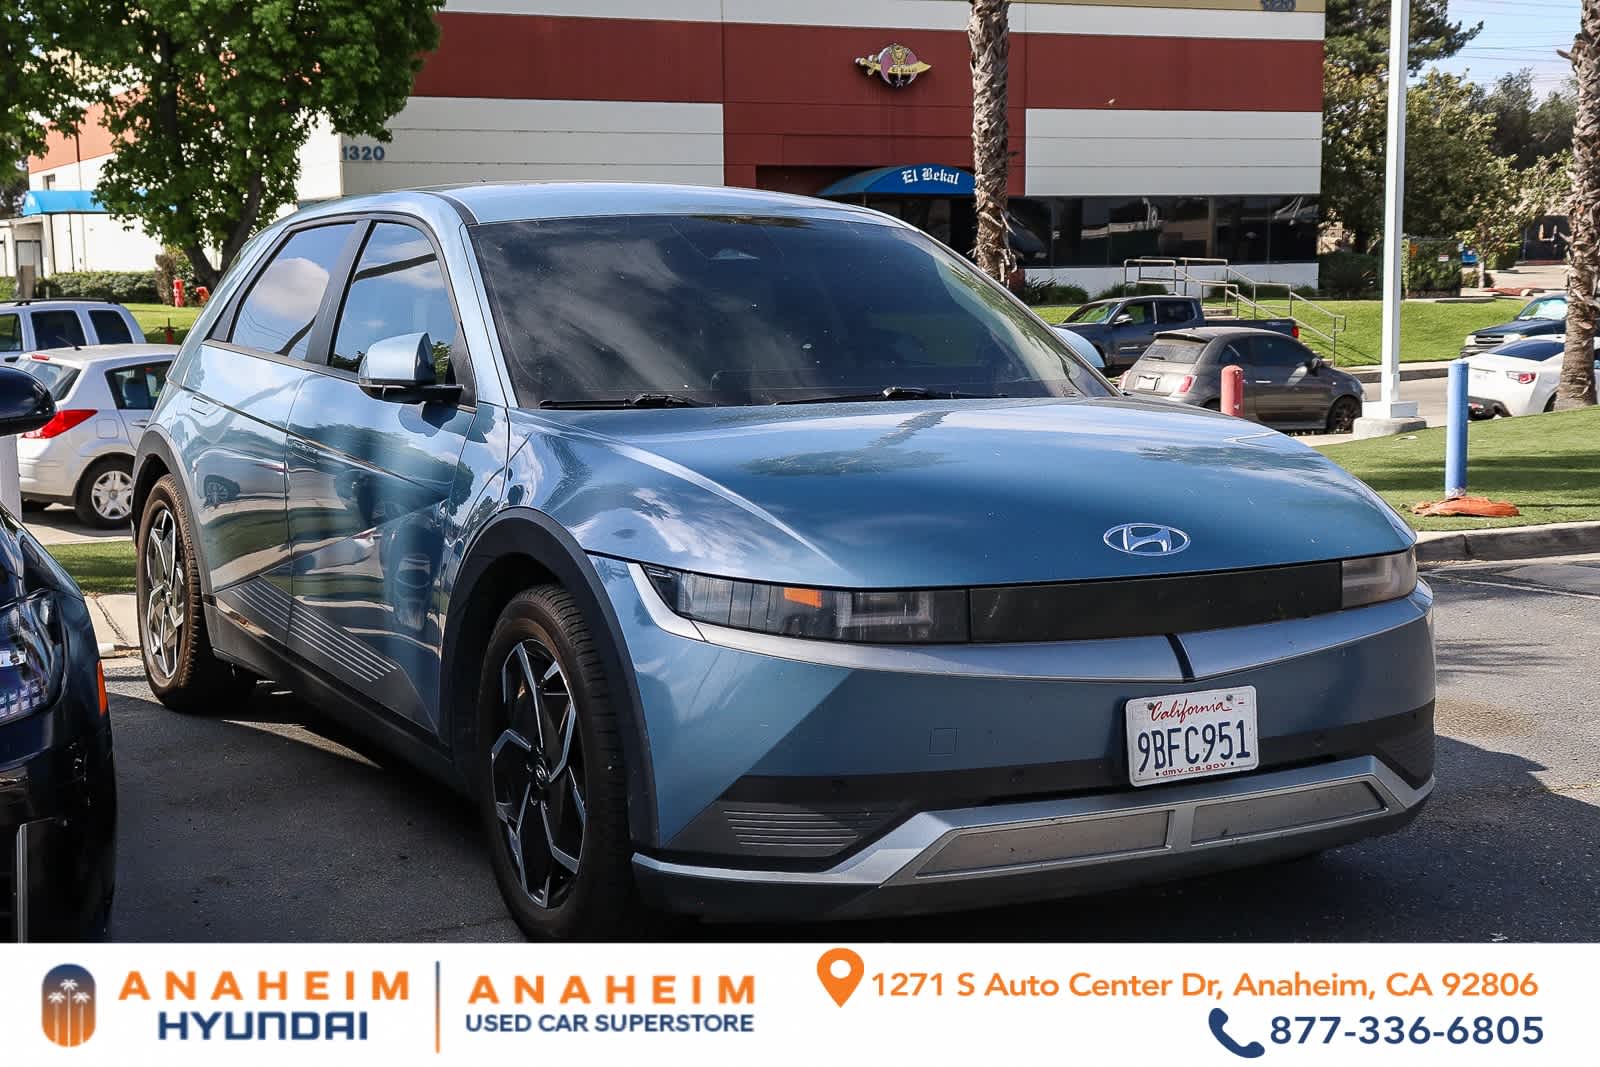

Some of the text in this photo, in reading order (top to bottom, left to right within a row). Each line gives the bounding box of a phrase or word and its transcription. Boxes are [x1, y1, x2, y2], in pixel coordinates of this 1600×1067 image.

[343, 145, 385, 161] 1320
[901, 167, 960, 185] El Bekal
[1151, 698, 1233, 723] California
[1137, 720, 1251, 773] 9BFC951
[1162, 761, 1227, 776] dmv.ca.gov
